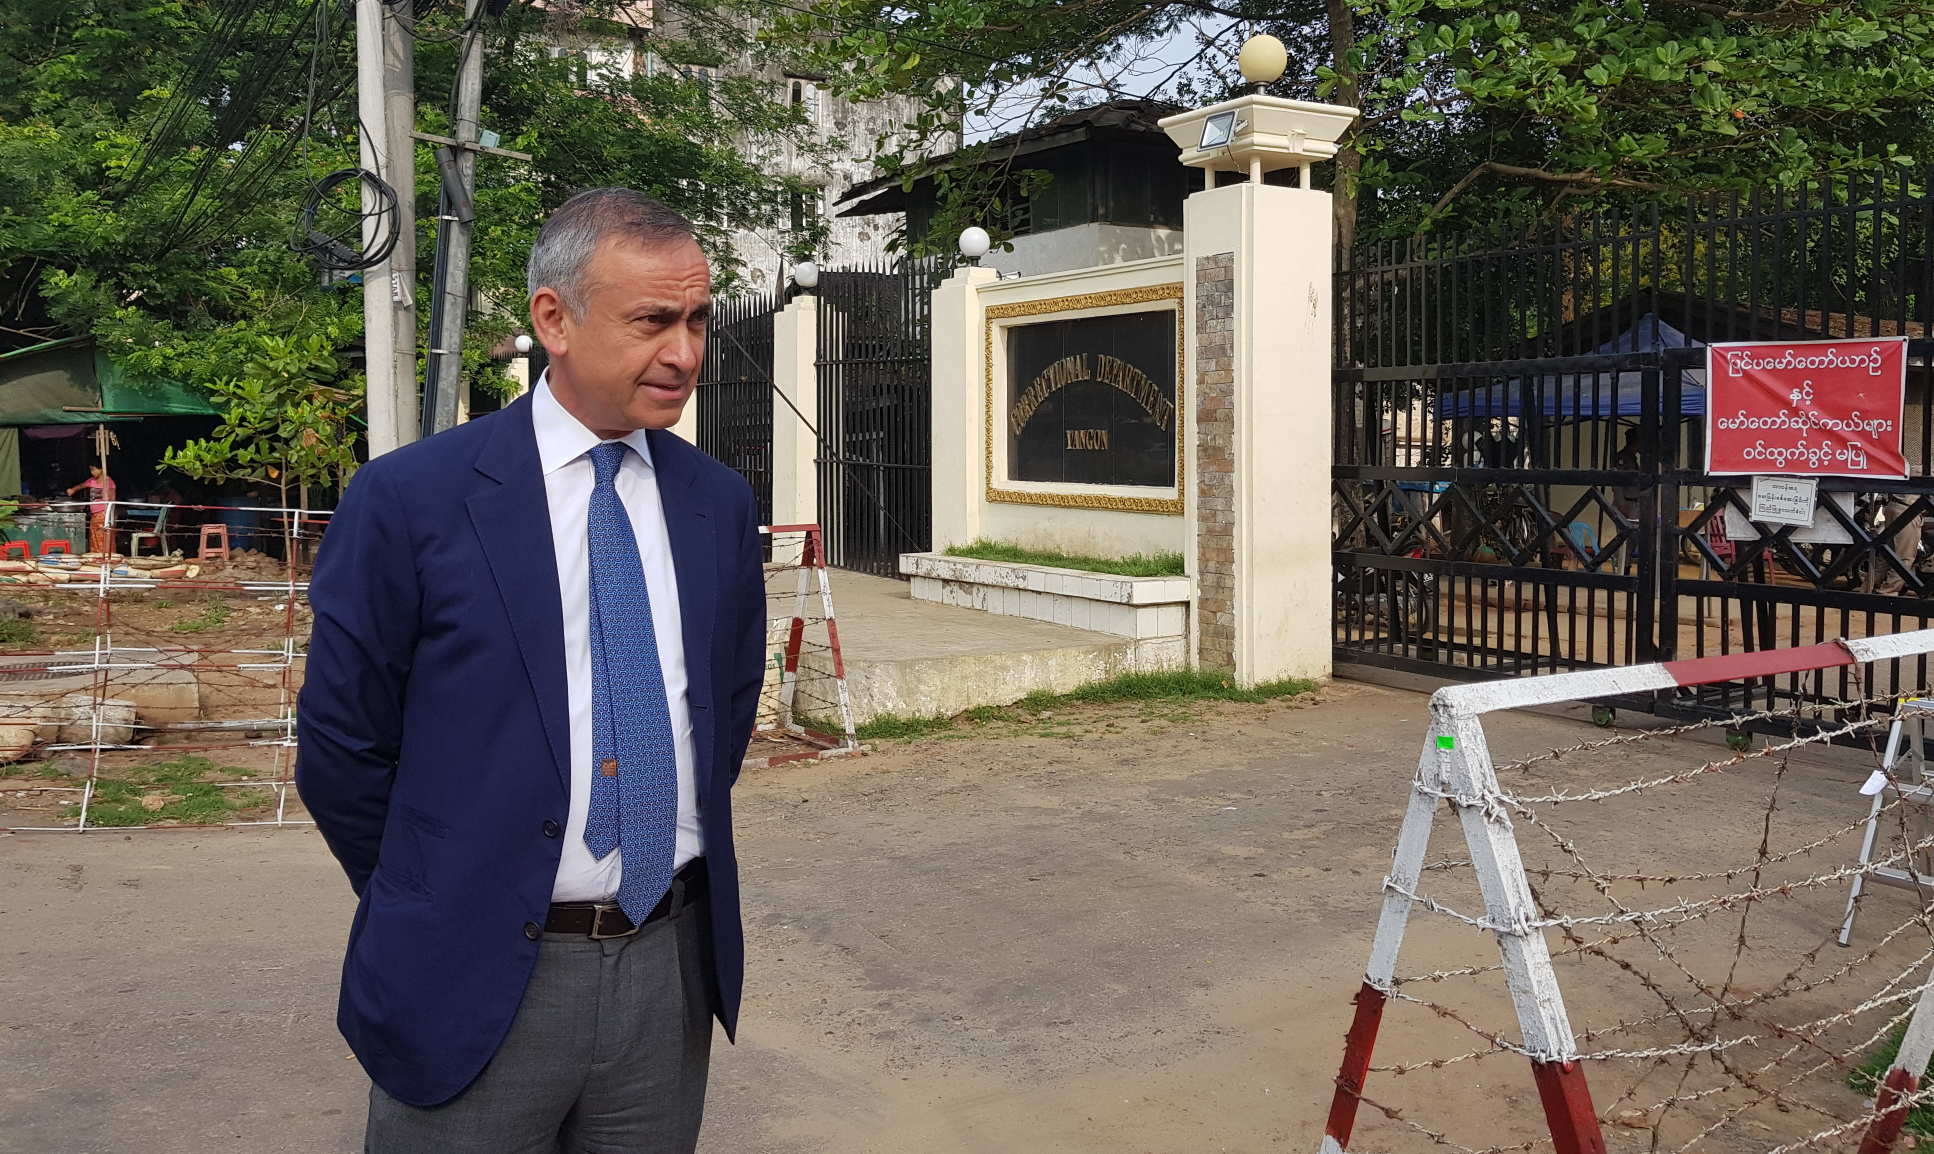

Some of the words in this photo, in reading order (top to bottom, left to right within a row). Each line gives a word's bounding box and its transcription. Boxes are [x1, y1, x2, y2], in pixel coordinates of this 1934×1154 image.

[1010, 353, 1091, 436] CORRECTIONAL
[1096, 354, 1174, 432] DEPARTMENT
[1789, 380, 1814, 407] နှင့်
[1718, 410, 1893, 439] မော်တော်ဆိုင်ကယ်များ
[1065, 430, 1109, 450] YANGON
[1743, 440, 1832, 468] ဝင်ထွက်ခွင့်
[1835, 442, 1867, 469] မပြု
